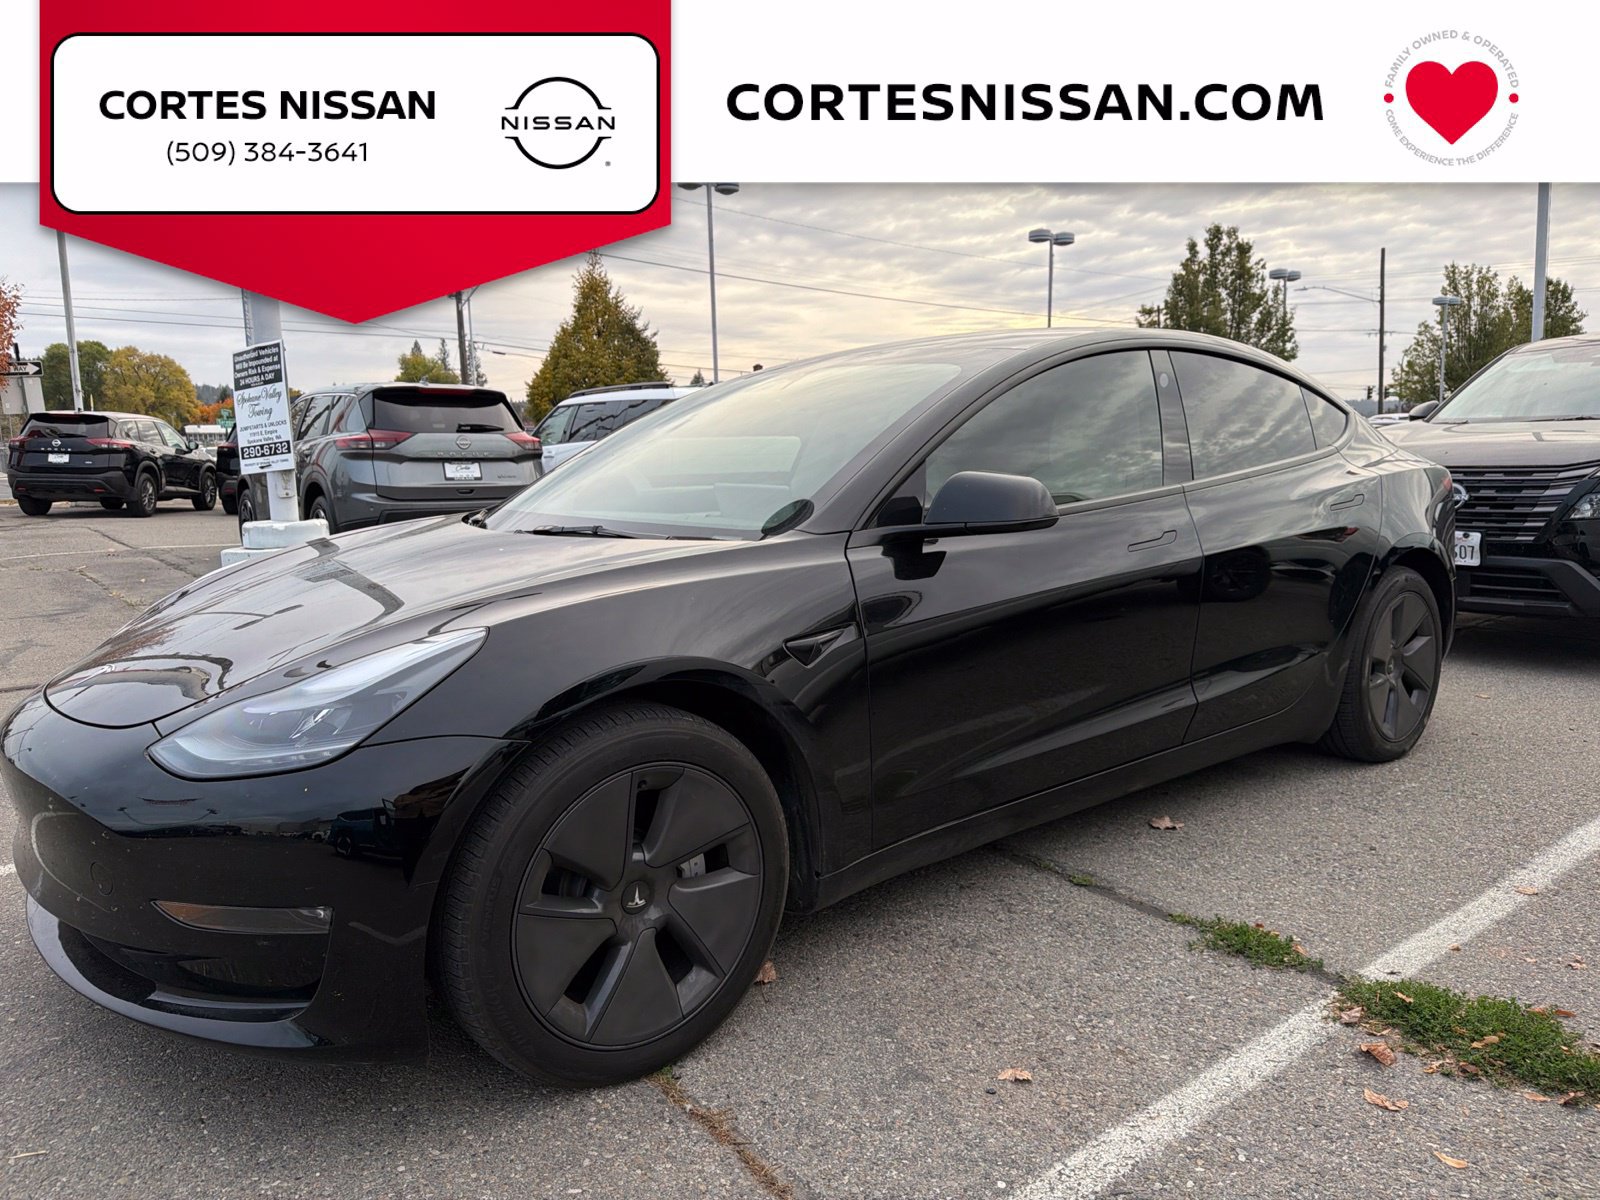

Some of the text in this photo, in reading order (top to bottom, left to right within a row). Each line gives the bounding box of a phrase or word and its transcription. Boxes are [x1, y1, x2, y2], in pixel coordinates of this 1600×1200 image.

[265, 372, 275, 381] DAY
[261, 384, 282, 404] Valley
[248, 402, 273, 420] Towing
[243, 442, 288, 459] 290-6732
